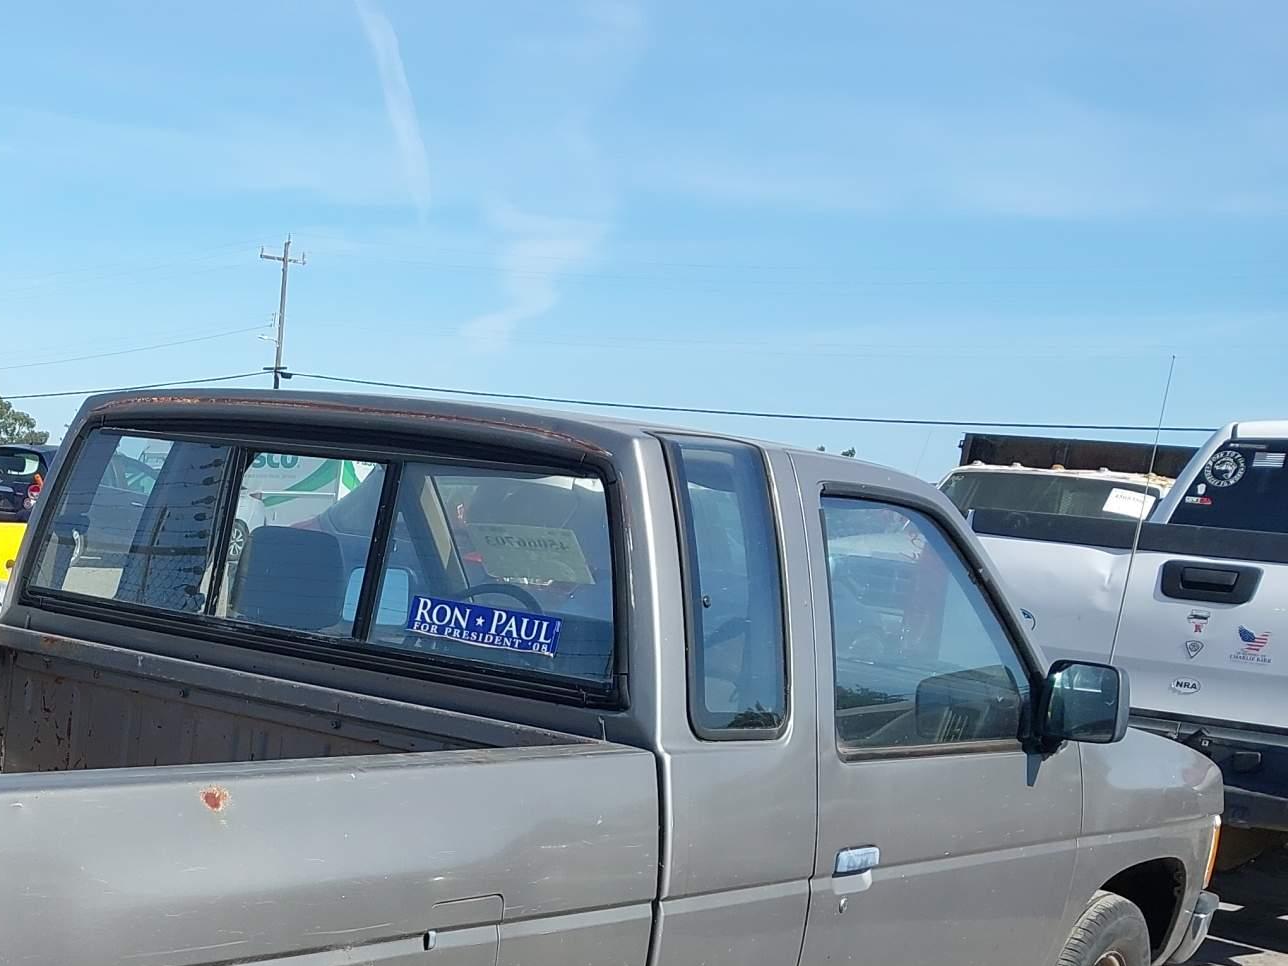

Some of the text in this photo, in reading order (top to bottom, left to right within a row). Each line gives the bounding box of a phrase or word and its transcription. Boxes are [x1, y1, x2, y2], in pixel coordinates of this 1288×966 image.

[415, 597, 552, 644] RON PAUL
[413, 621, 438, 633] FOR
[444, 627, 522, 649] PRESIDENT
[1175, 680, 1198, 691] NRA
